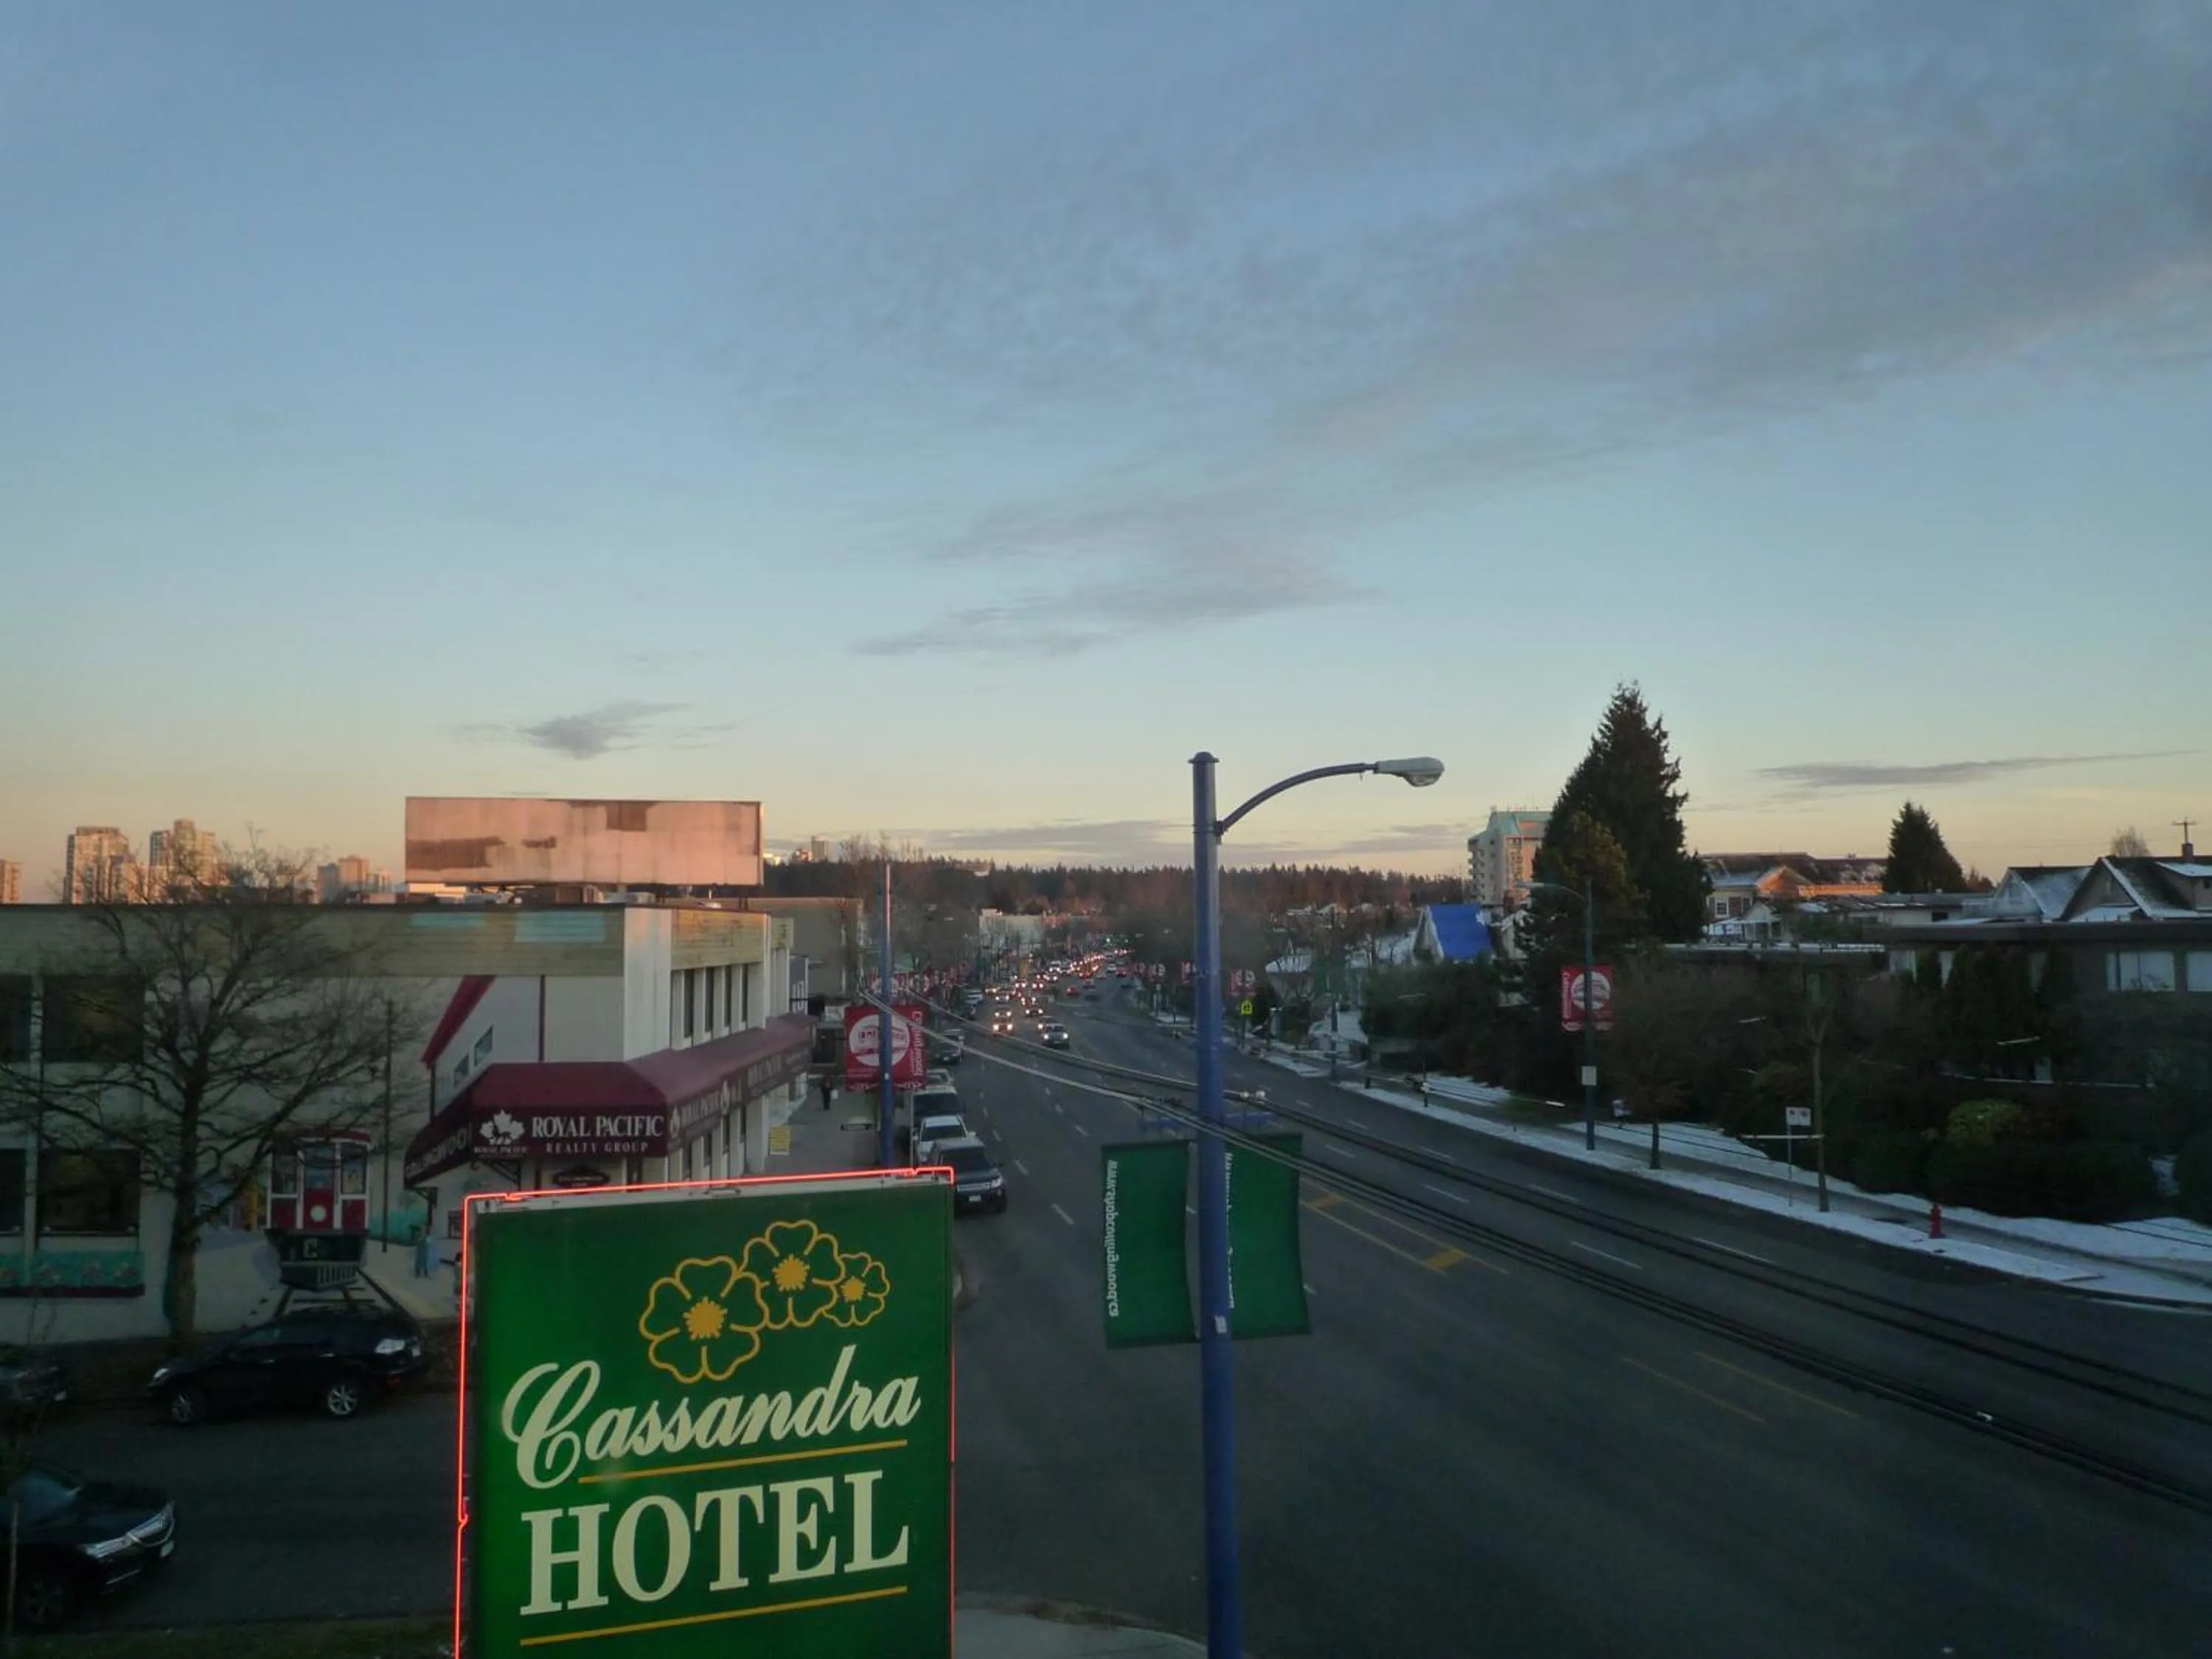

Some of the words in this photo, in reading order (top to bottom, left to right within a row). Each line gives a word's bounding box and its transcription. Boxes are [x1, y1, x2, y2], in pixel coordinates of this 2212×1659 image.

[532, 1116, 591, 1138] ROYAL
[595, 1115, 664, 1138] PACIFIC
[546, 1141, 598, 1154] REALTY
[604, 1141, 649, 1153] GROUP
[501, 1344, 921, 1489] Cassandra
[520, 1470, 908, 1616] HOTEL
